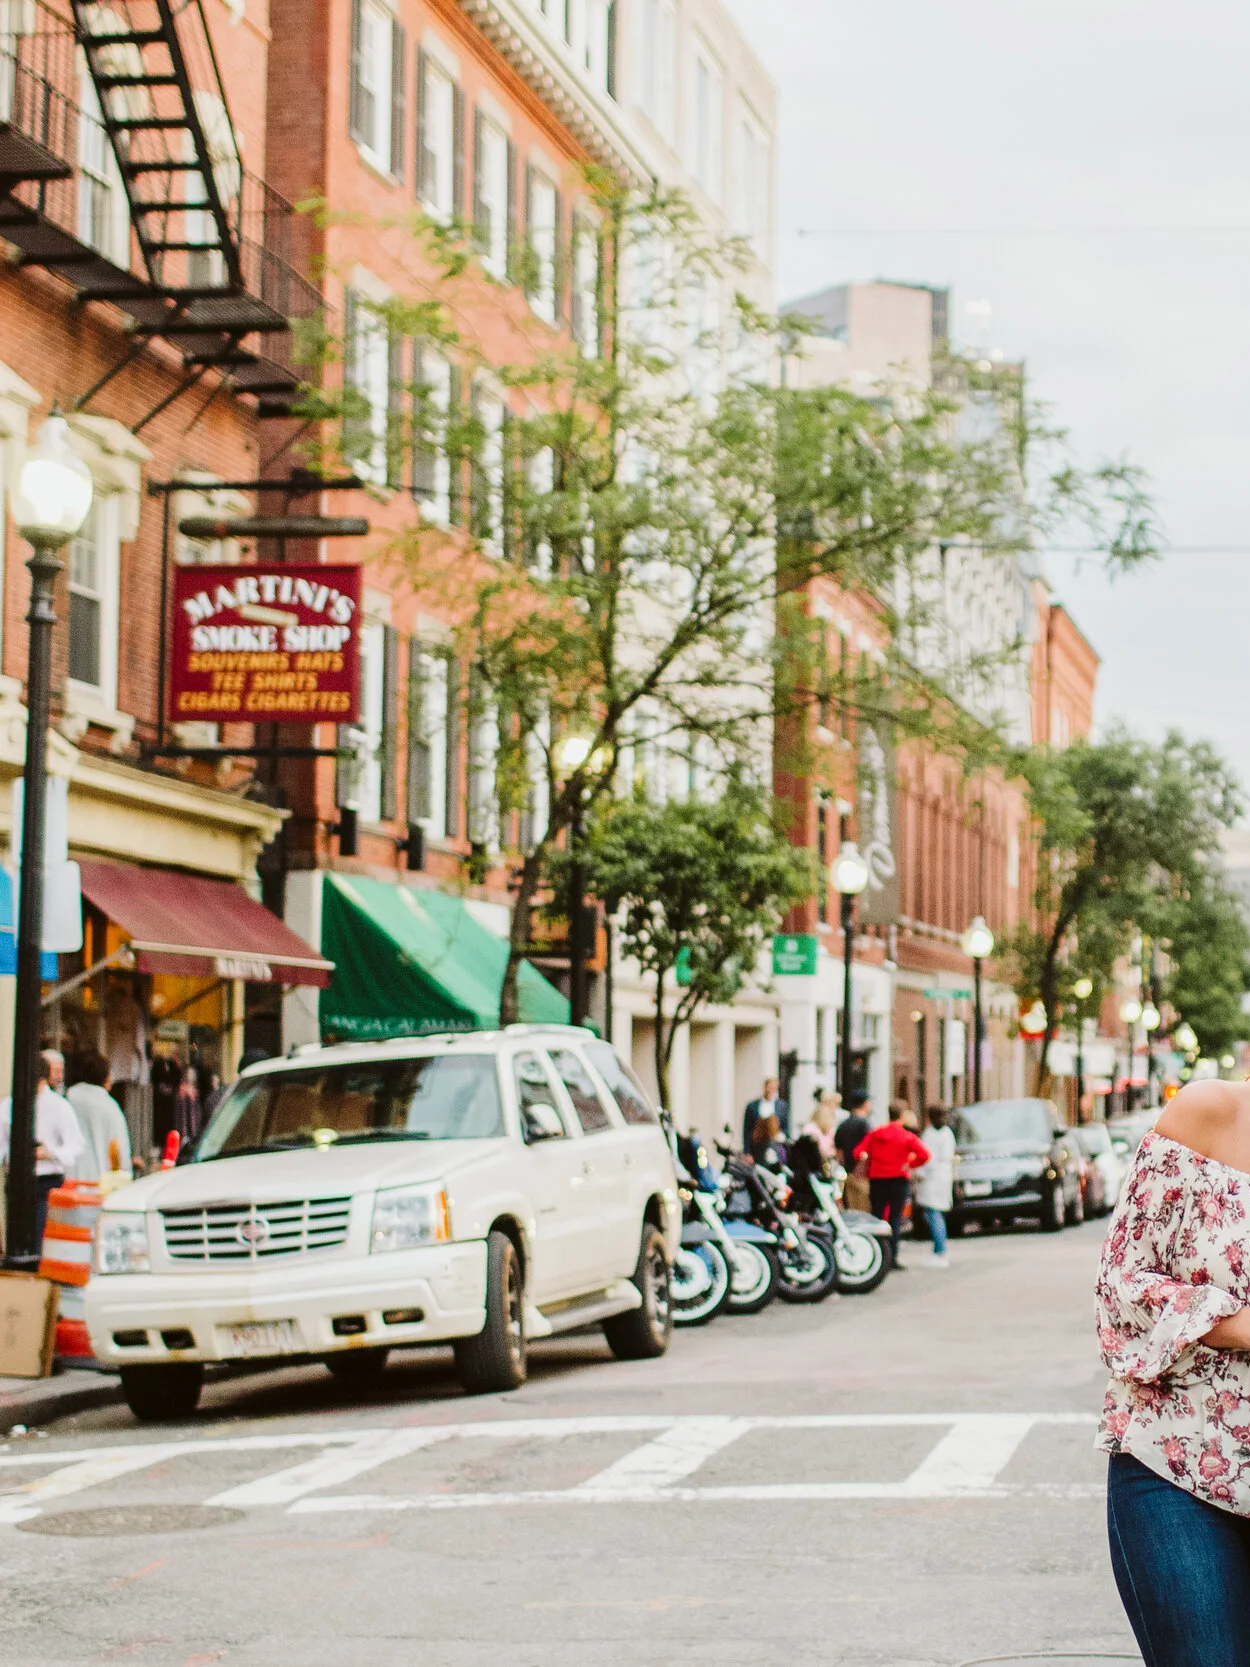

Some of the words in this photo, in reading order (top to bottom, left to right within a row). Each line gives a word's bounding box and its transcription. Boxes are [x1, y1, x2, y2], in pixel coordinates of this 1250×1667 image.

[183, 574, 356, 626] MARTINI'S
[191, 625, 278, 652] SMOKE
[283, 625, 351, 652] SHOP
[188, 652, 290, 673] SOUVENIRS
[294, 652, 344, 673] HATS
[212, 672, 247, 691] TEE
[252, 672, 318, 691] SHIRTS
[177, 691, 242, 712] CIGARS
[245, 691, 350, 712] CIGARETTES
